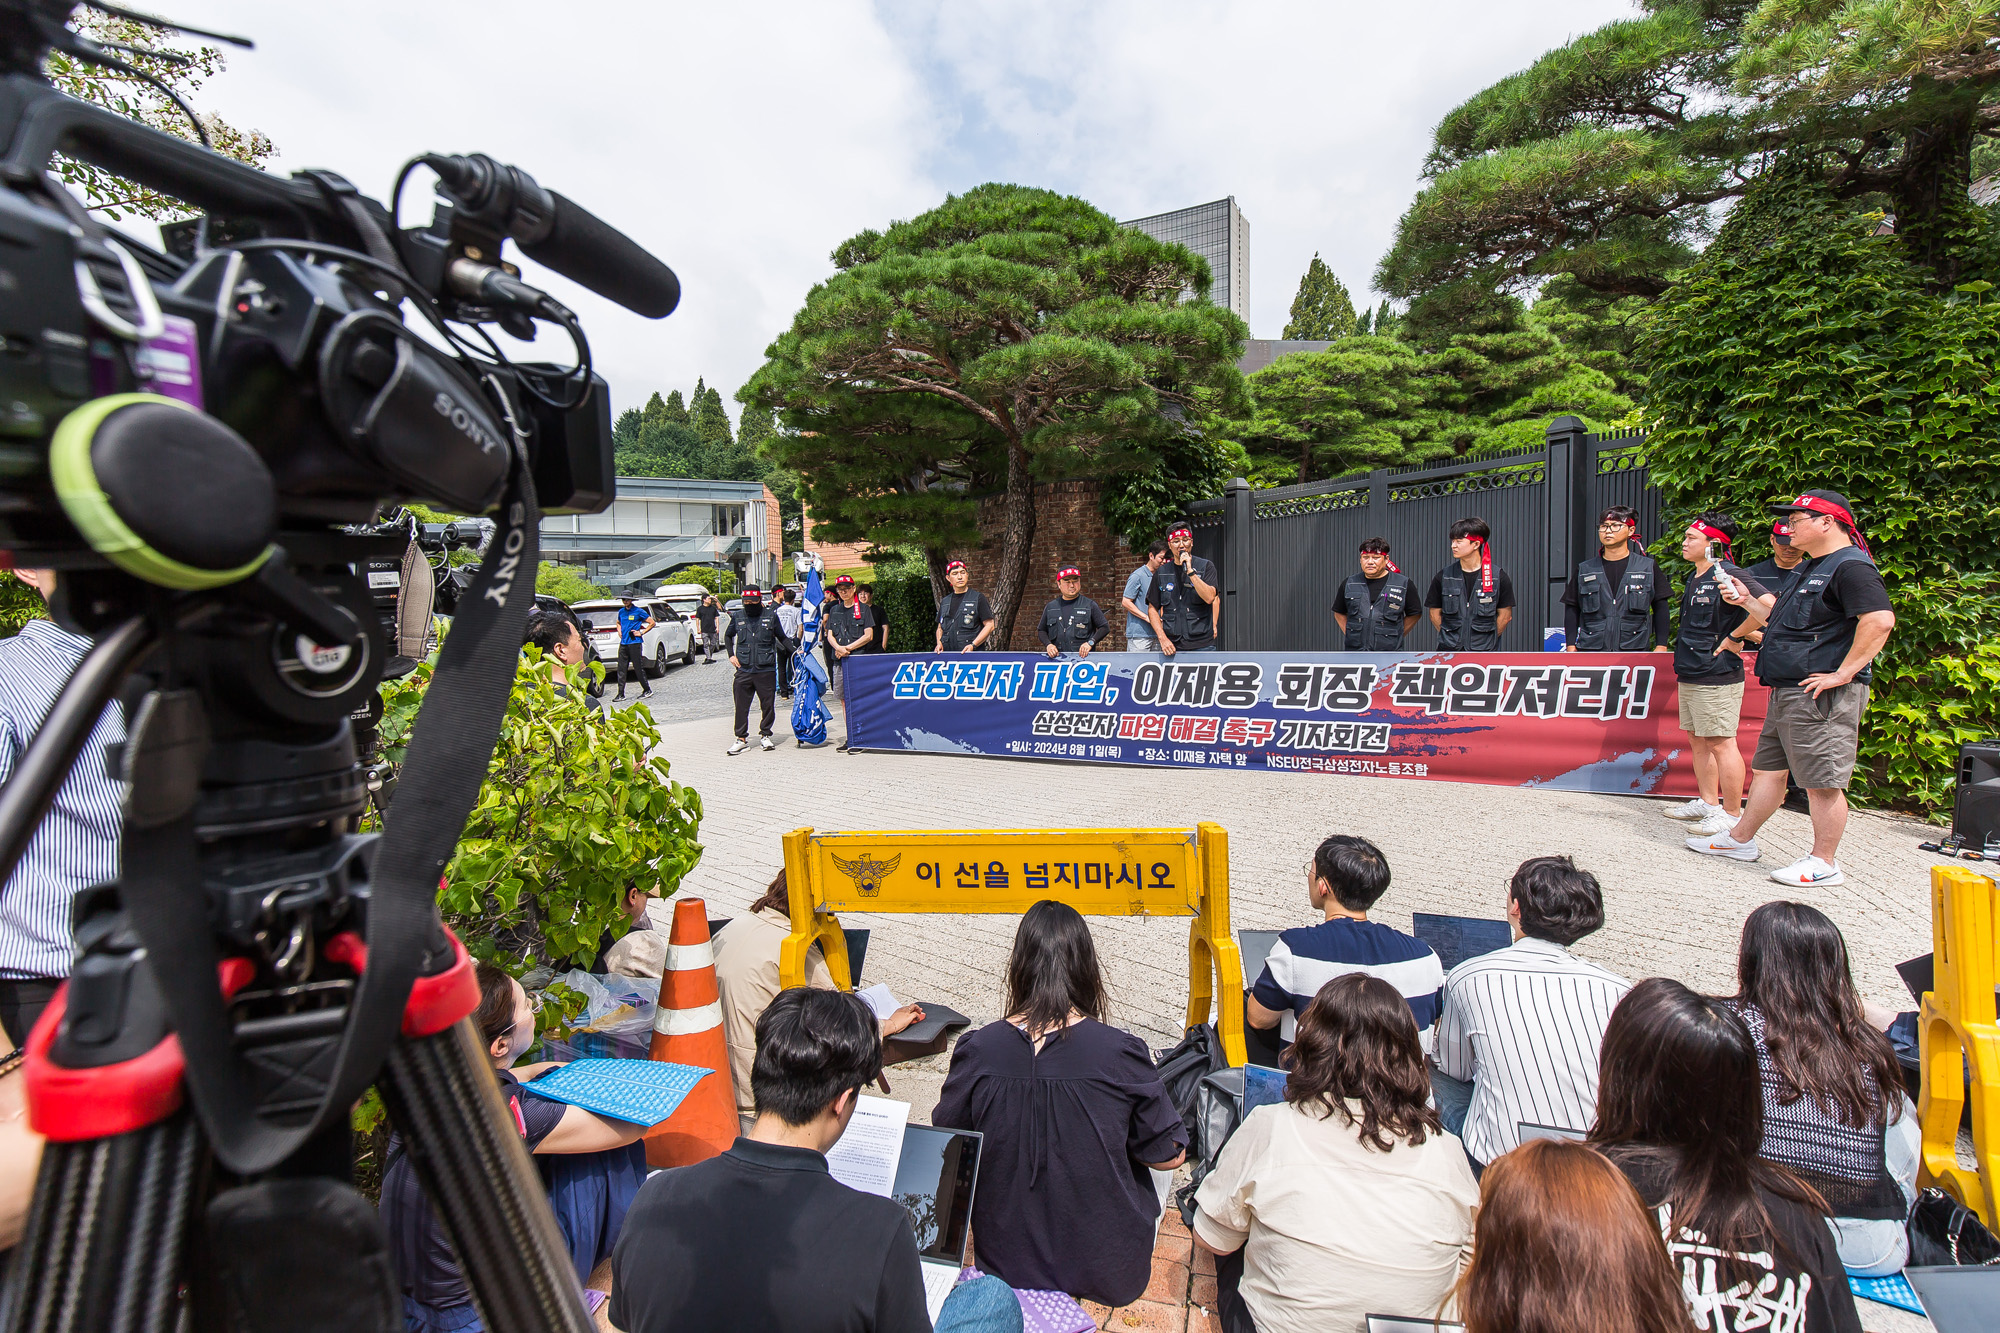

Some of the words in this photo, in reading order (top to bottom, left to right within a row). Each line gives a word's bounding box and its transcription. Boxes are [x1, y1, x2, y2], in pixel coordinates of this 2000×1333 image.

[433, 392, 497, 455] SONY
[485, 501, 526, 608] SONY
[892, 661, 1025, 702] 삼성전자
[1029, 661, 1119, 705] 파업,
[1131, 662, 1263, 709] 이재용
[1273, 663, 1377, 712] 회장
[1389, 663, 1656, 720] 책임져라!
[350, 712, 372, 720] OZEN
[1032, 710, 1120, 738] 삼성전자
[1117, 713, 1168, 741] 파업
[1168, 715, 1221, 743] 해결
[1222, 717, 1277, 747] 촉구
[1277, 720, 1391, 753] 기자회견
[1011, 740, 1032, 753] 일시:
[1034, 742, 1068, 756] 2024년
[1069, 744, 1086, 757] 8월
[1089, 745, 1122, 759] 1일(목)
[1145, 748, 1170, 761] 장소:
[1173, 750, 1206, 764] 이재용
[1208, 751, 1232, 766] 자택
[1235, 752, 1248, 767] 앞
[1266, 755, 1429, 777] NSEU전국삼성전자노동조합
[915, 862, 941, 888] 이
[953, 861, 1010, 889] 선을
[1023, 862, 1176, 890] 넘지마시오
